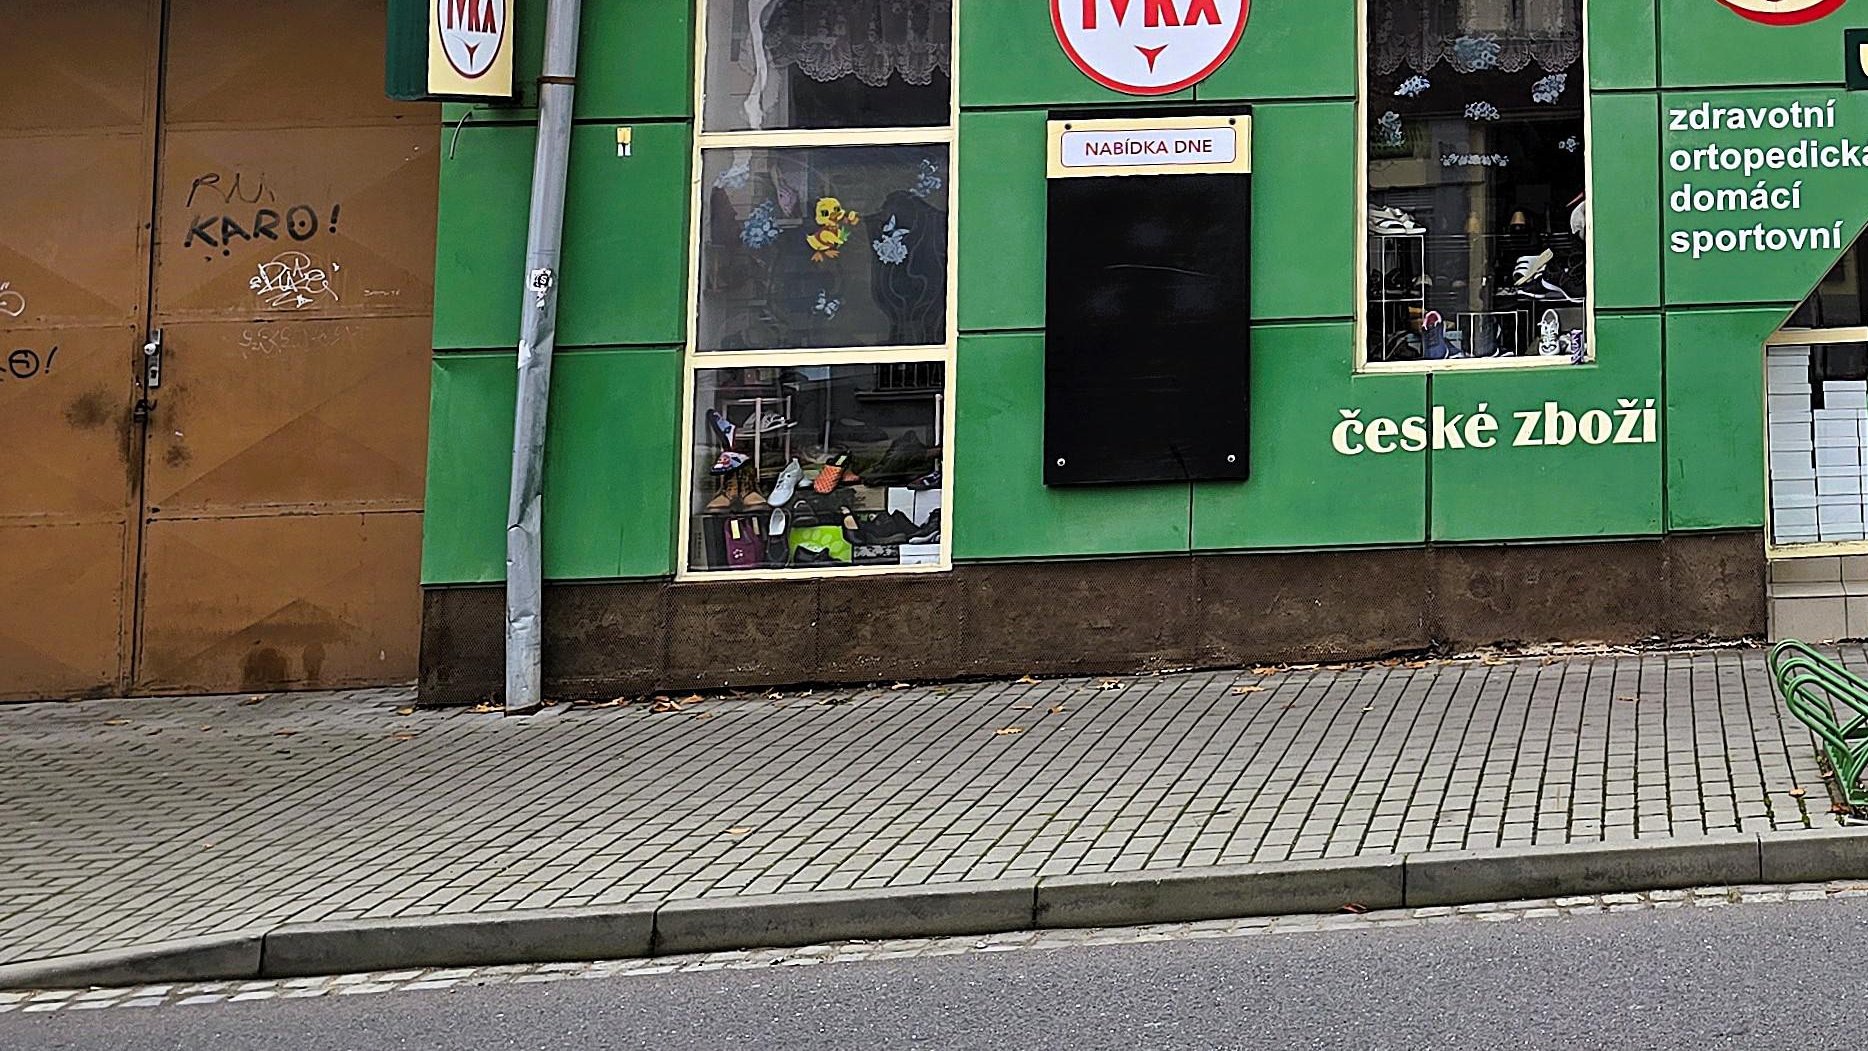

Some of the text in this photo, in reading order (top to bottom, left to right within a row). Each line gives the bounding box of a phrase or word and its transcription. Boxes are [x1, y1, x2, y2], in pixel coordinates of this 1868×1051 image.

[1669, 99, 1836, 131] zdravotní
[1085, 138, 1212, 156] NABÍDKA DNE
[1670, 181, 1802, 212] domácí
[1670, 221, 1843, 259] sportovní
[1331, 398, 1657, 455] české zboží
